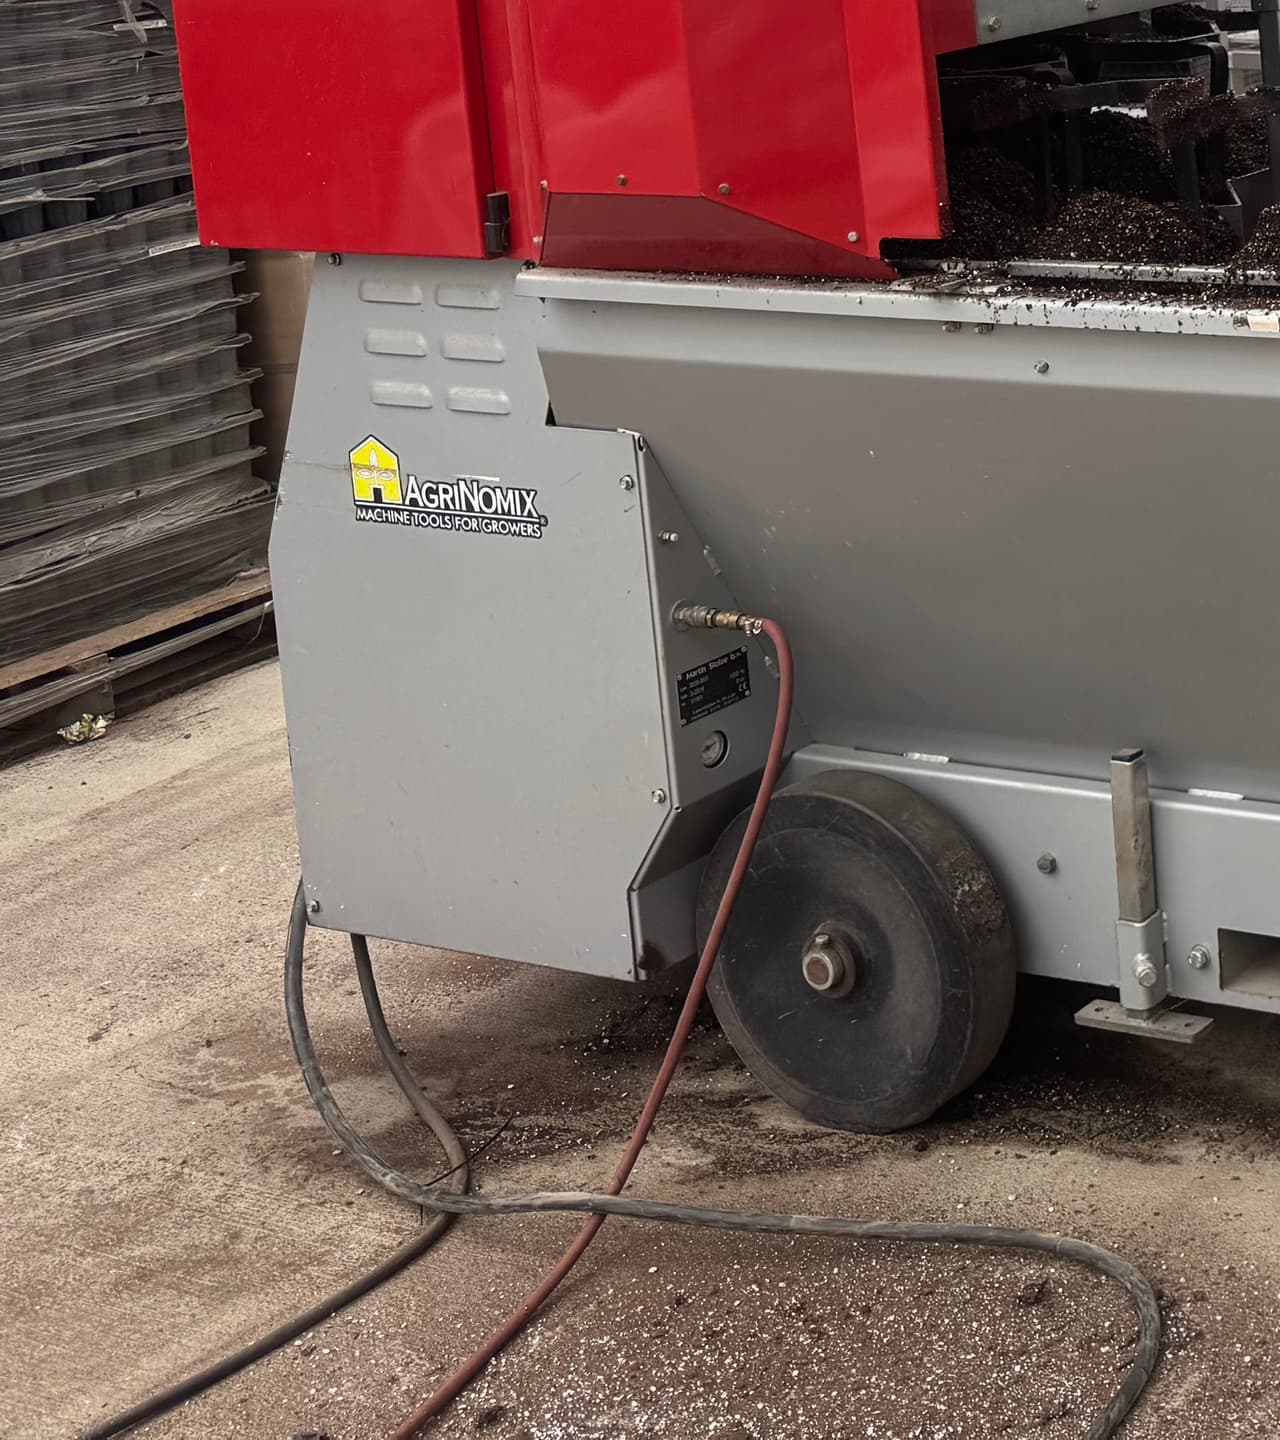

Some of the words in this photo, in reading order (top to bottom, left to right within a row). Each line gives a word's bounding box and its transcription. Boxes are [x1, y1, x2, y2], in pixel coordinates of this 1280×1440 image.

[356, 508, 411, 526] MACHINE
[412, 512, 451, 530] TOOLS
[454, 517, 480, 533] FOR
[481, 519, 542, 538] GROWERS
